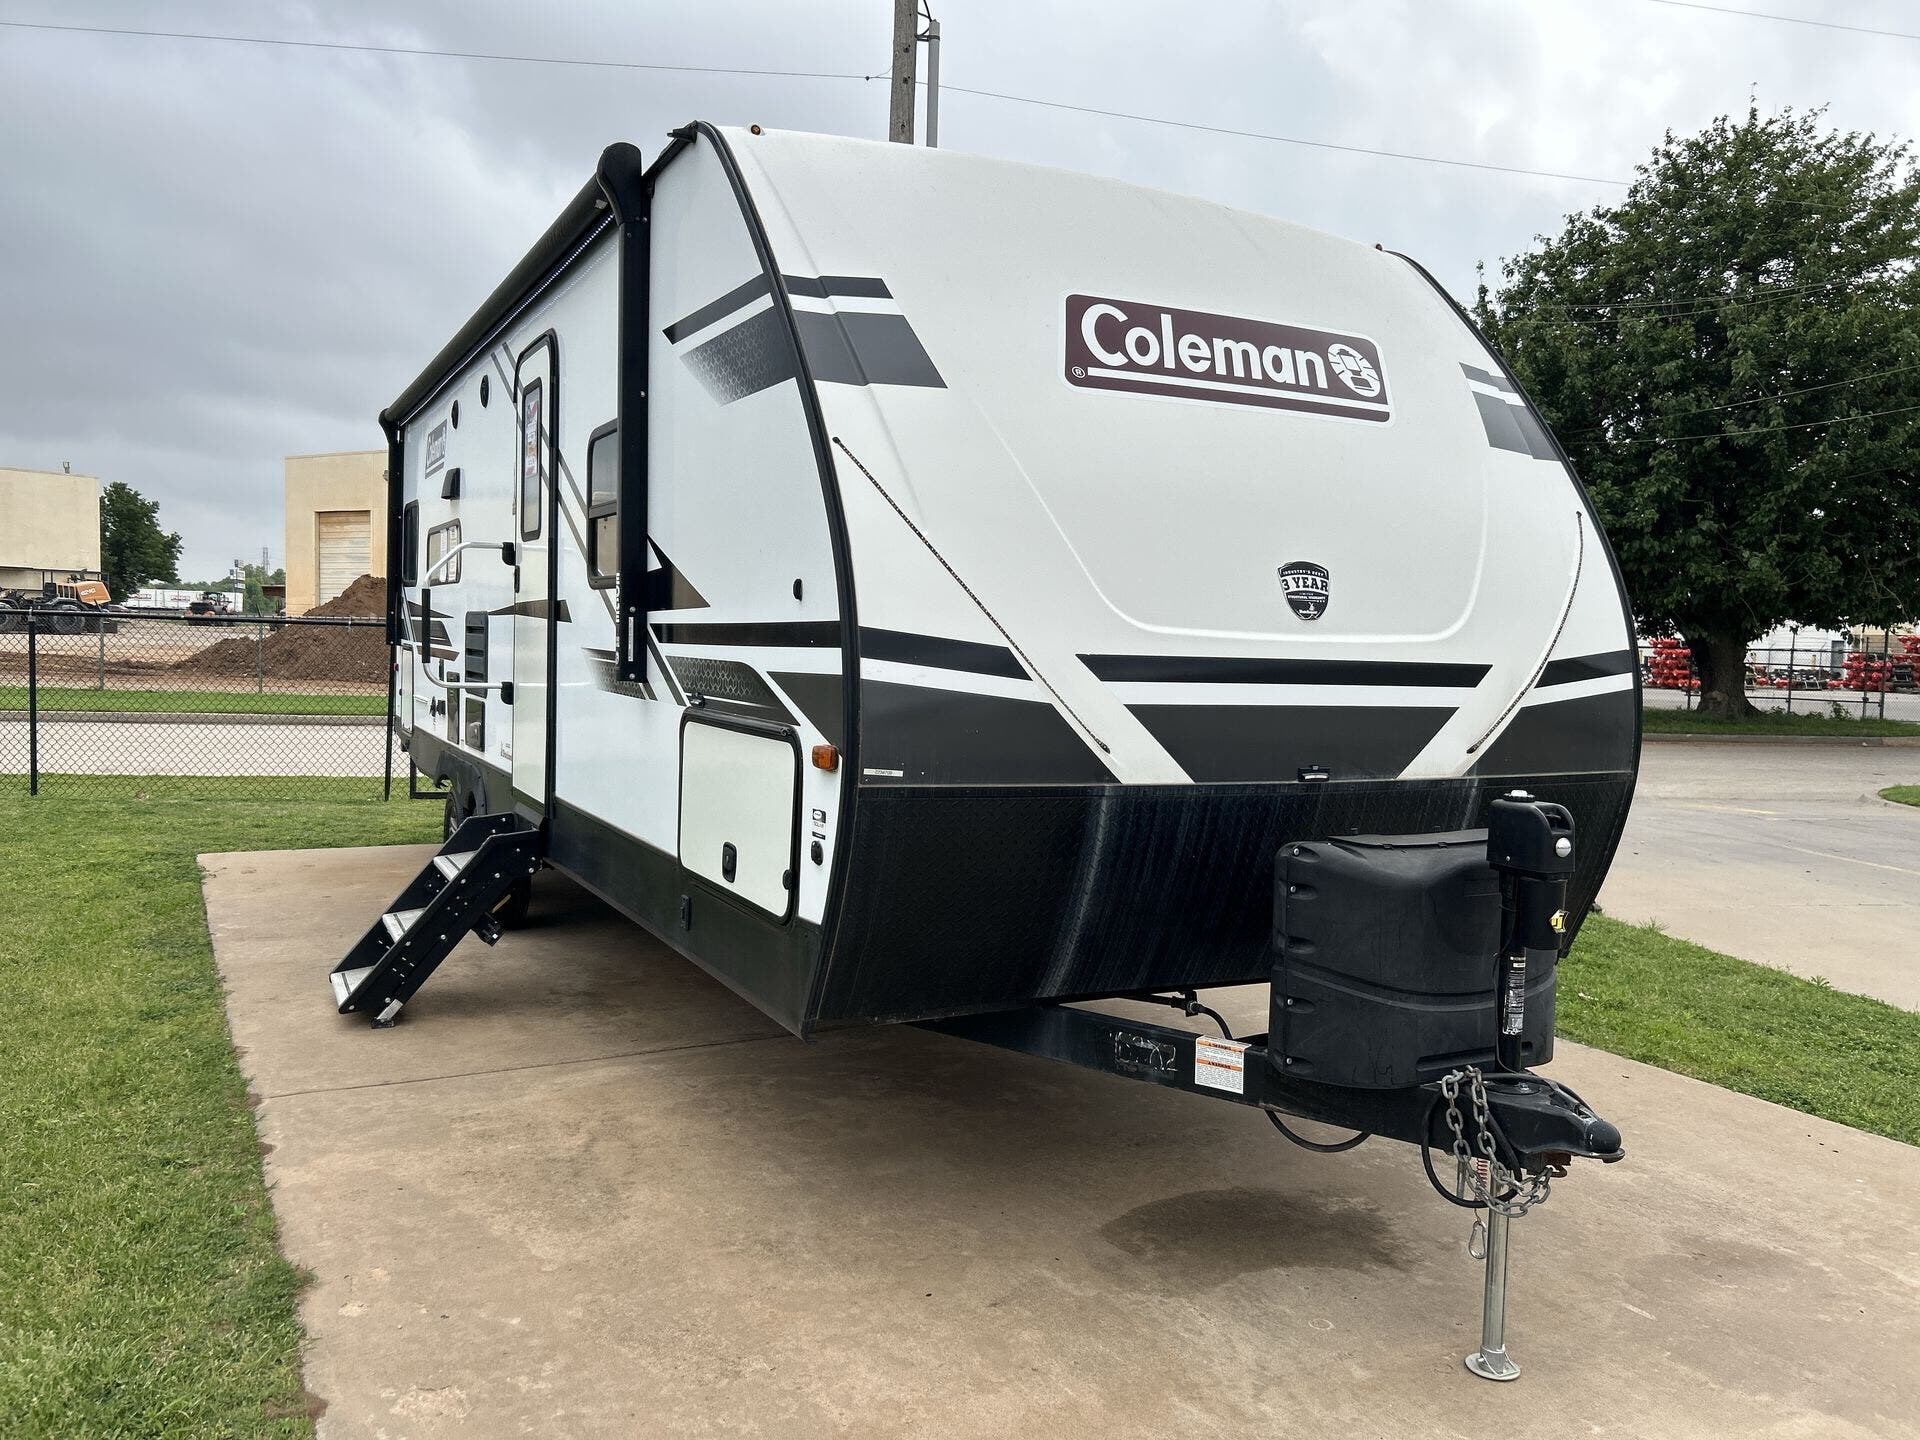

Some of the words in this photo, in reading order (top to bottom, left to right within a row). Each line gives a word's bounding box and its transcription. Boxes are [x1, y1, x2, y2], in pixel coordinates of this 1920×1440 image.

[1081, 304, 1328, 389] Coleman
[1281, 579, 1290, 591] 3
[1292, 577, 1328, 592] YEAR
